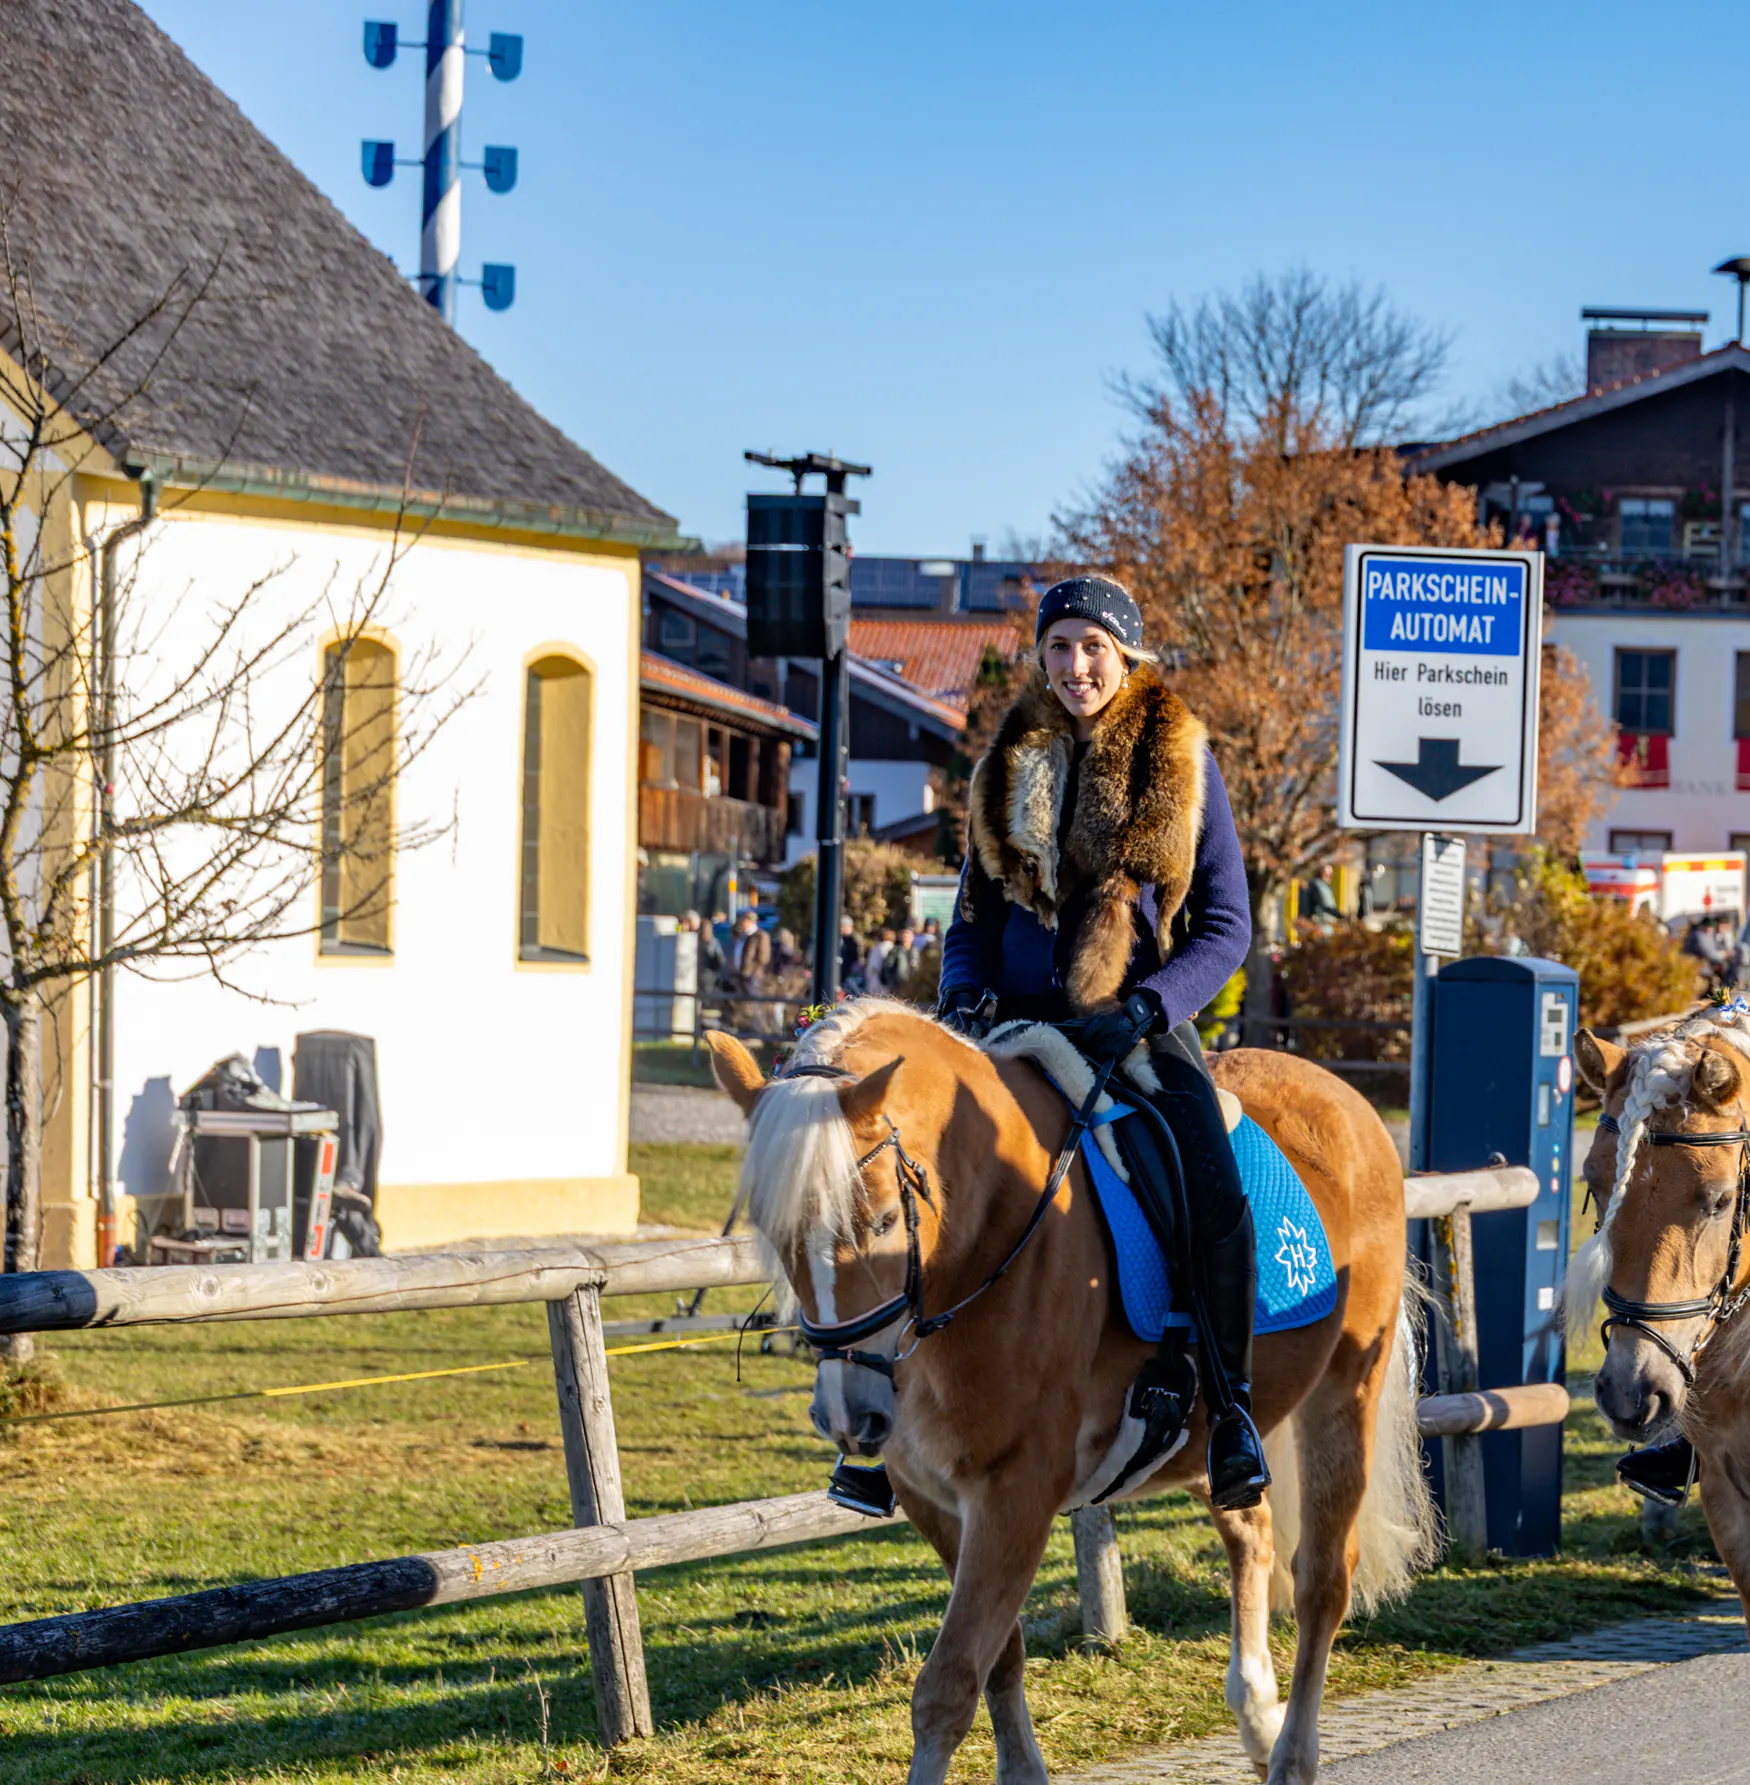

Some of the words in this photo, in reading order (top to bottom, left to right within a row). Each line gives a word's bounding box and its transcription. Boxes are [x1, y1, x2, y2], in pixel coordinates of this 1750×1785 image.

[1367, 570, 1520, 605] PARKSCHEIN-
[1390, 612, 1496, 644] AUTOMAT
[1373, 660, 1409, 681] Hier
[1417, 662, 1509, 686] Parkschein
[1417, 696, 1463, 718] lösen
[1289, 1243, 1306, 1269] H
